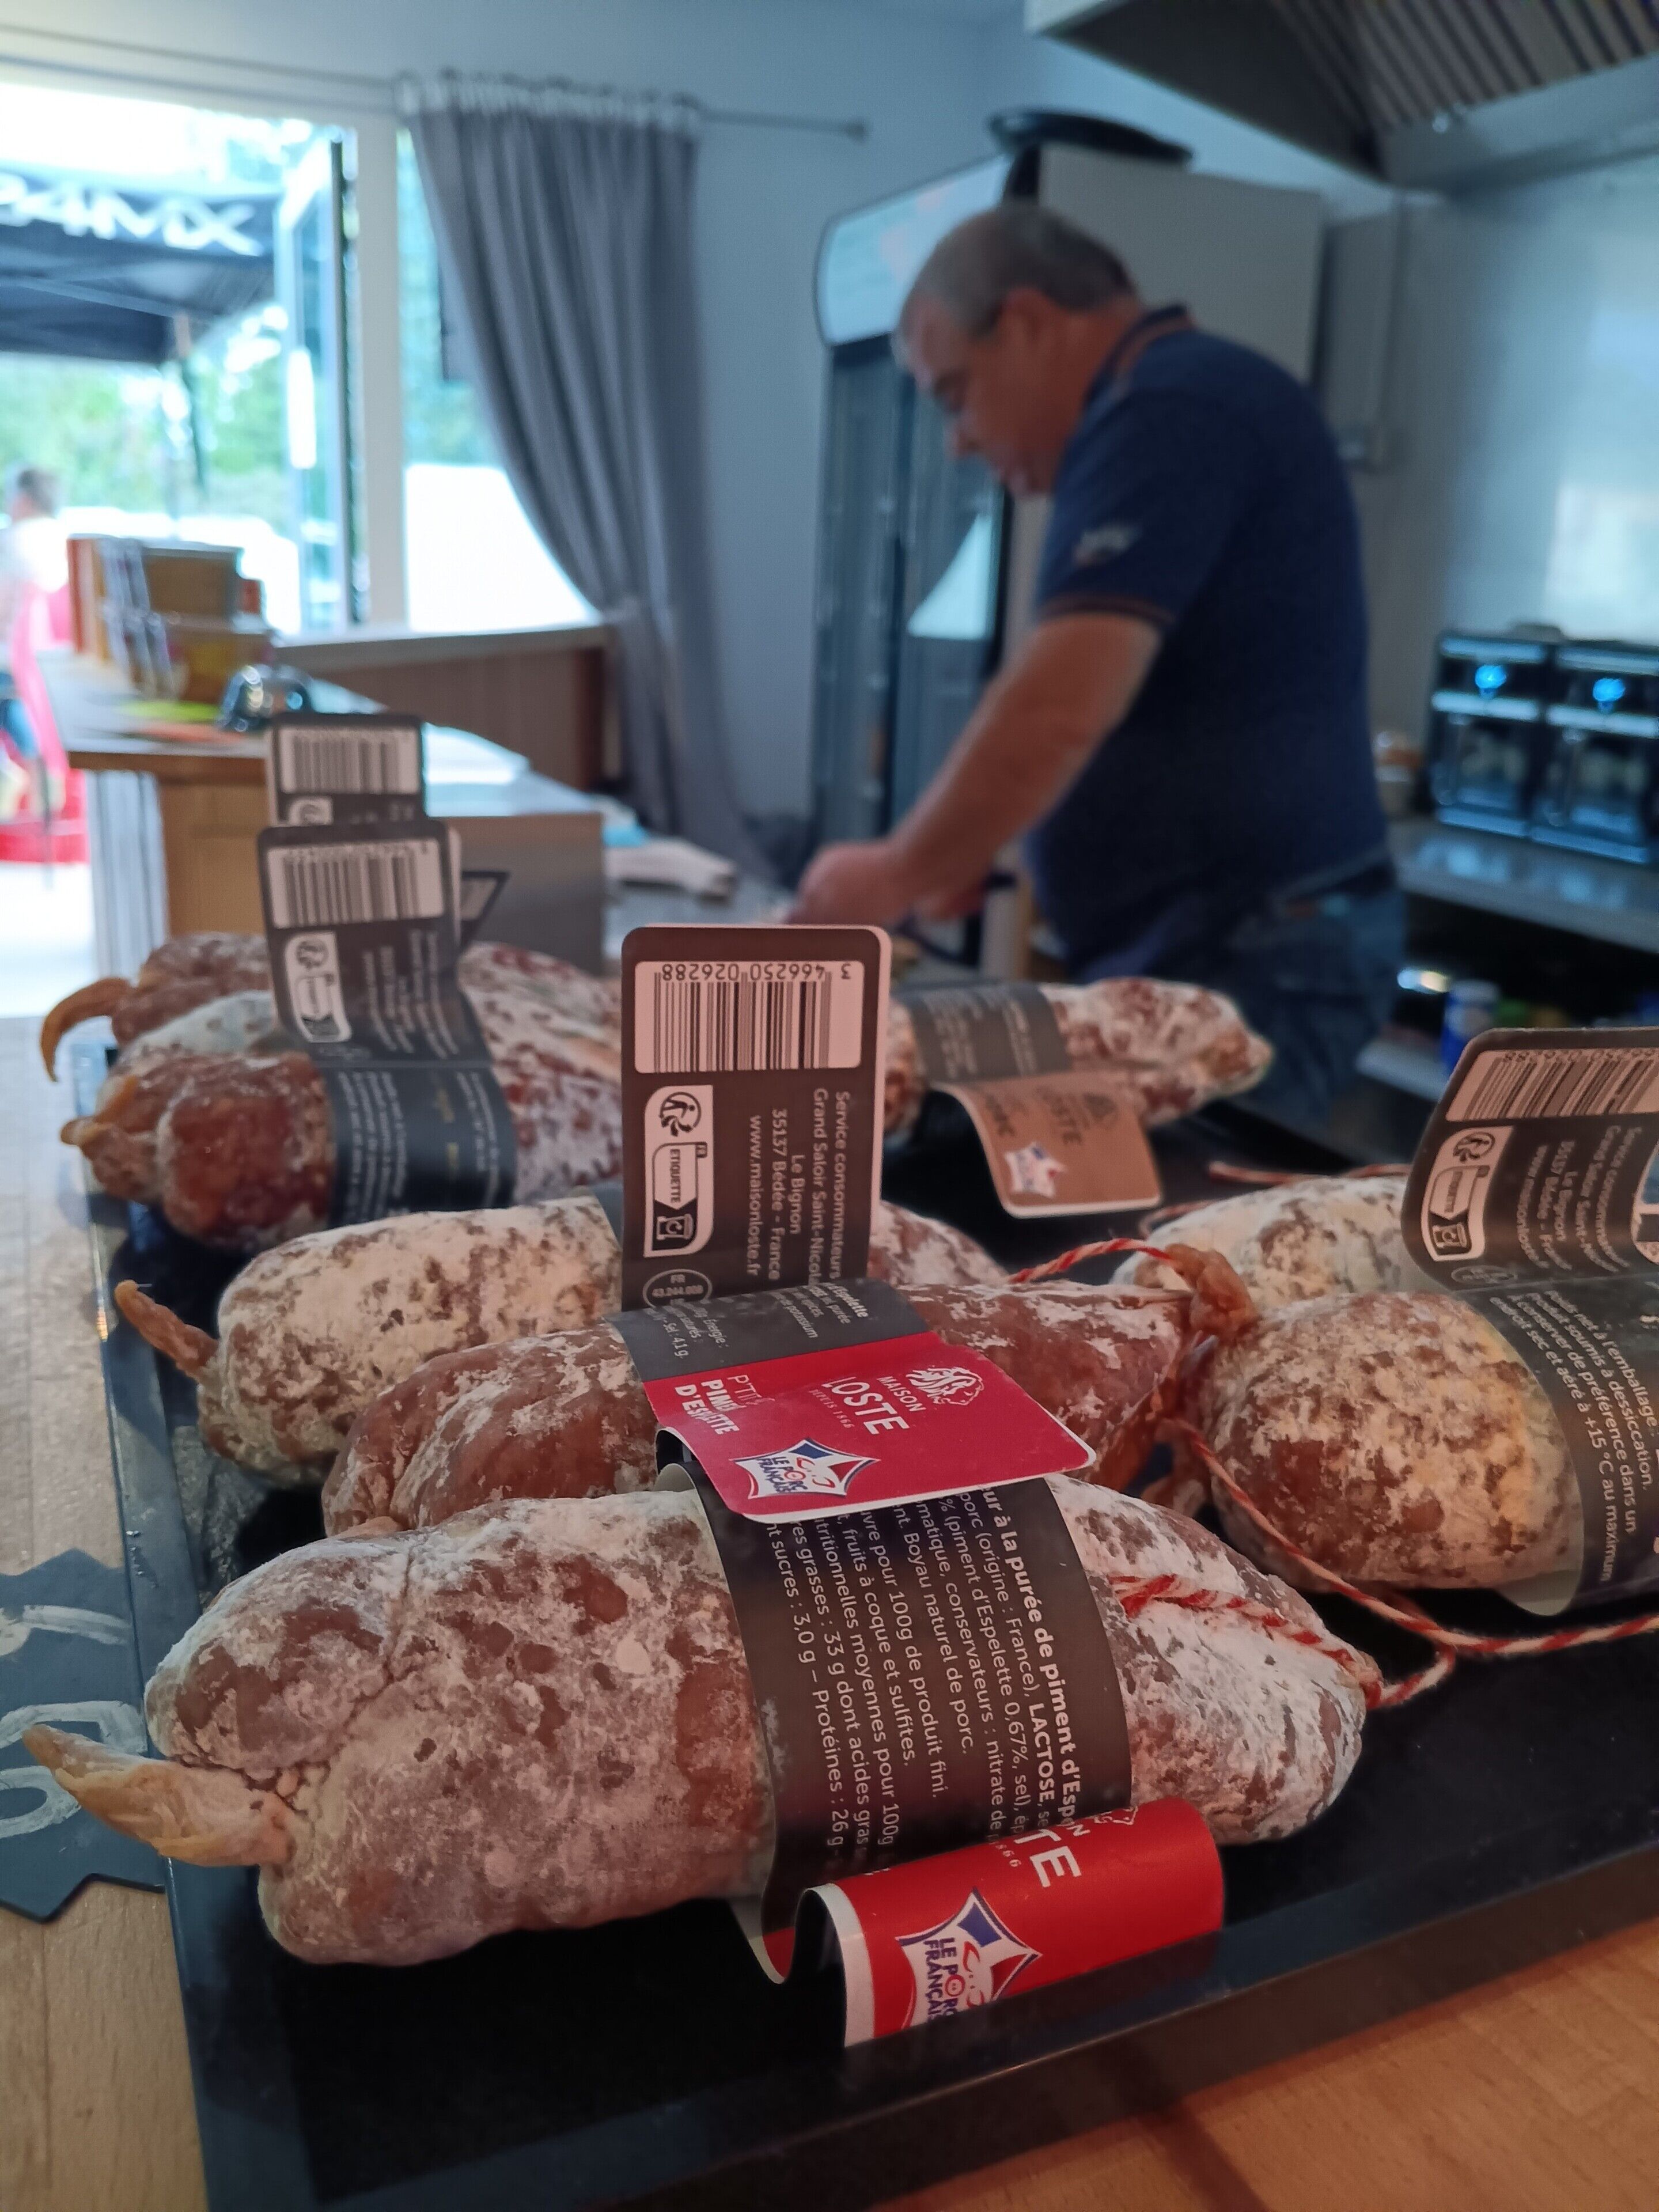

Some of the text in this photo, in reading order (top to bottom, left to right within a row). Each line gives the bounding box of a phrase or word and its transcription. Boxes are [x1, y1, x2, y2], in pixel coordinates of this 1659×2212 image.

[661, 962, 852, 981] 3 466250 026288
[772, 1109, 787, 1156] 35137
[814, 1089, 828, 1138] Grand
[669, 1149, 681, 1203] ETIQUETTE
[772, 1161, 786, 1210] Bédée
[813, 1143, 828, 1187] Saloir
[830, 1092, 850, 1279] Service consommateurs
[747, 1115, 763, 1275] www.maisonloste.fr
[788, 1155, 805, 1234] Le Bignon
[769, 1228, 785, 1279] France
[1527, 1331, 1550, 1350] sec
[1546, 1351, 1563, 1365] et
[1567, 1352, 1586, 1369] de
[821, 1377, 910, 1434] LOSTE
[877, 1376, 926, 1411] MAISON
[1557, 1368, 1585, 1398] aéré
[1602, 1342, 1657, 1427] l'emballage
[1565, 1325, 1606, 1366] soumis
[1609, 1381, 1652, 1490] dessiccation.
[1577, 1403, 1590, 1412] à
[1579, 1372, 1627, 1460] préférence
[1585, 1417, 1607, 1448] +15
[772, 1455, 791, 1467] LE
[1599, 1452, 1613, 1474] °C
[1602, 1479, 1615, 1500] au
[1620, 1465, 1635, 1506] dans
[994, 1516, 1011, 1527] à
[1001, 1532, 1017, 1551] la
[1602, 1505, 1619, 1580] maximum
[1626, 1510, 1635, 1532] un
[772, 1541, 799, 1597] sucres
[843, 1529, 866, 1571] fruits
[870, 1546, 897, 1585] pour
[904, 1533, 931, 1588] Boyau
[944, 1516, 980, 1584] (piment
[796, 1549, 829, 1615] grasses
[859, 1577, 874, 1586] à
[1005, 1557, 1042, 1622] purée
[794, 1613, 814, 1643] 3,0
[865, 1593, 891, 1653] coque
[889, 1592, 912, 1640] 100g
[924, 1594, 958, 1662] naturel
[798, 1650, 816, 1663] g
[824, 1631, 844, 1656] 33
[906, 1646, 922, 1671] de
[946, 1583, 993, 1722] conservateurs
[956, 1492, 983, 1528] porc
[975, 1533, 1009, 1601] (origine
[1006, 1618, 1040, 1696] France),
[1029, 1703, 1054, 1806] LACTOSE,
[972, 1589, 1012, 1696] d'Espelette
[1035, 1628, 1054, 1657] de
[828, 1662, 845, 1675] g
[850, 1634, 886, 1742] moyennes
[884, 1660, 900, 1680] et
[946, 1668, 963, 1692] de
[837, 1681, 860, 1731] dont
[889, 1685, 915, 1765] sulfites.
[909, 1677, 942, 1755] produit
[949, 1699, 973, 1753] porc.
[1040, 1664, 1075, 1754] piment
[812, 1690, 842, 1791] Protéines
[1005, 1702, 1028, 1768] 0,67%,
[849, 1737, 871, 1804] acides
[873, 1748, 894, 1797] pour
[930, 1760, 948, 1797] fini.
[986, 1741, 1005, 1805] nitrate
[1014, 1775, 1031, 1810] sel),
[827, 1836, 843, 1845] g
[832, 1809, 849, 1832] 26
[853, 1810, 870, 1844] gras
[878, 1804, 899, 1844] 100g
[990, 1810, 1006, 1829] de
[938, 1937, 957, 1958] LE
